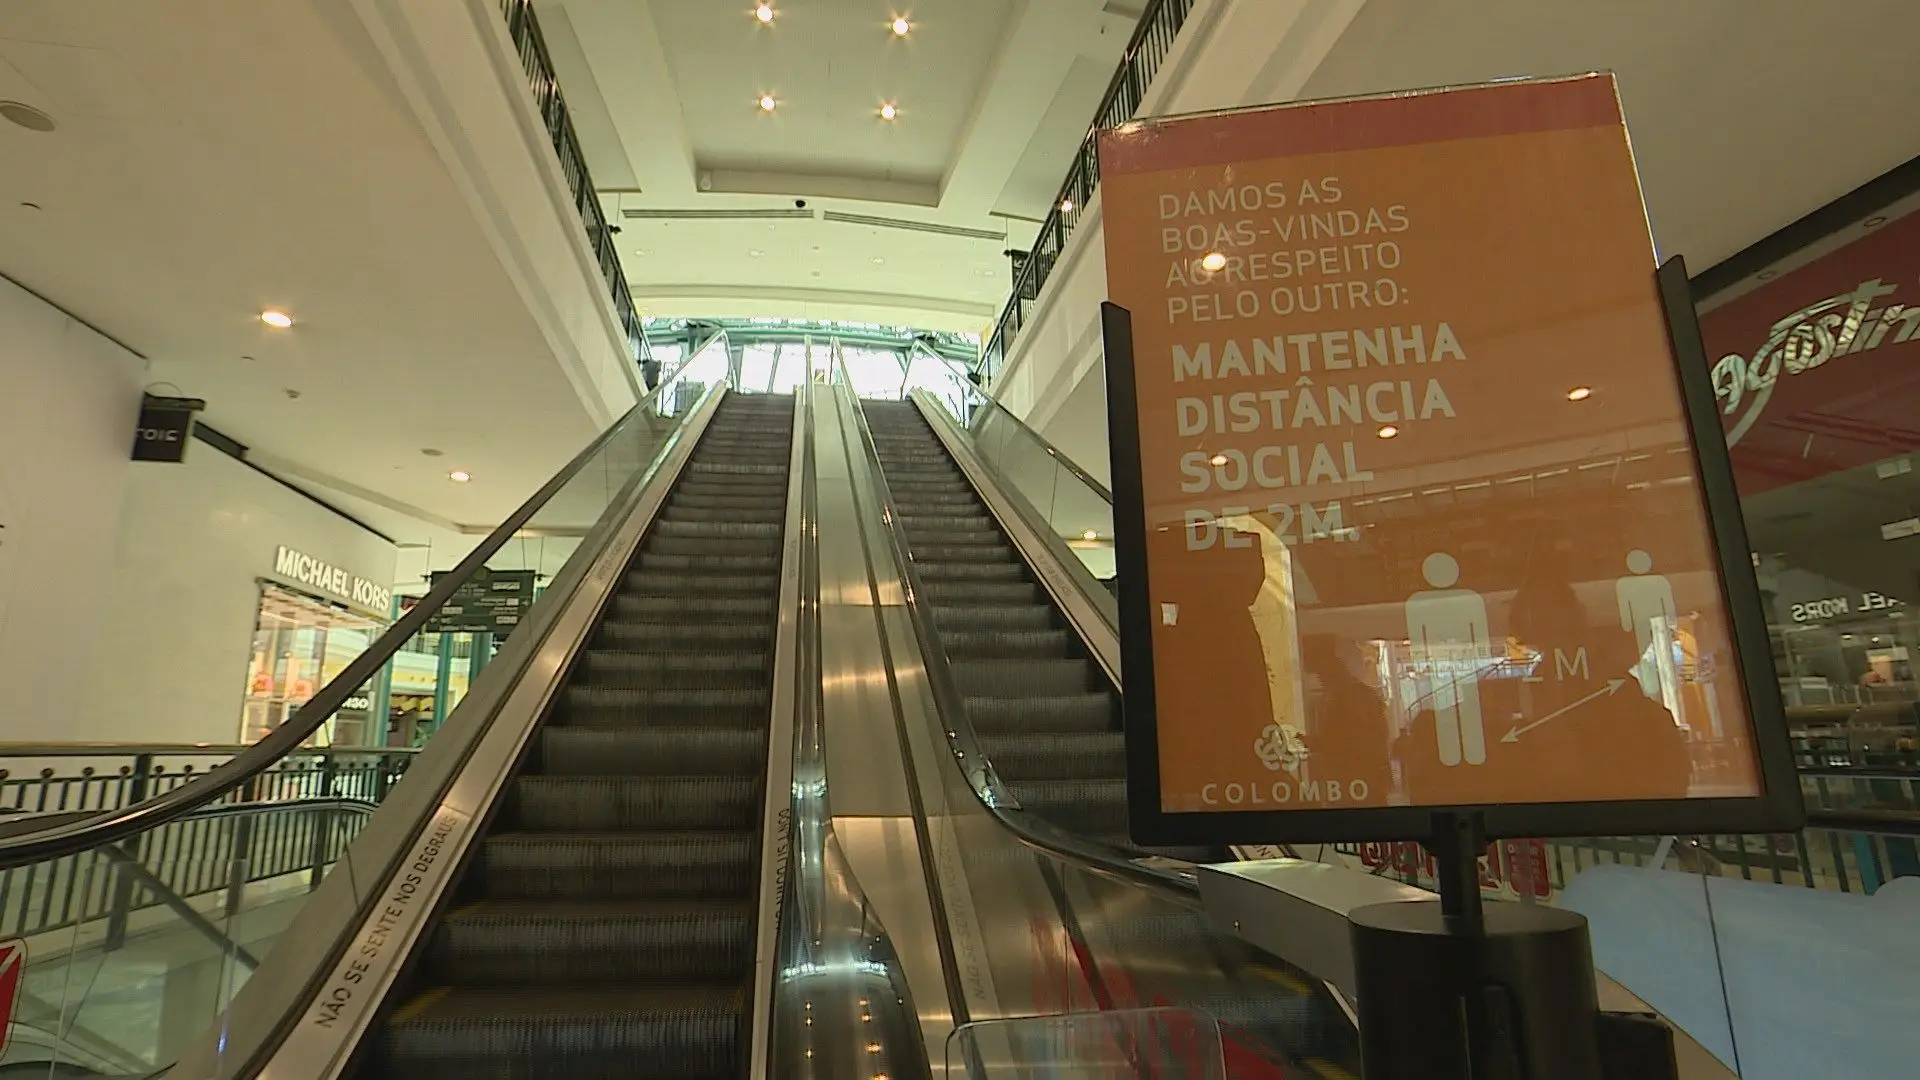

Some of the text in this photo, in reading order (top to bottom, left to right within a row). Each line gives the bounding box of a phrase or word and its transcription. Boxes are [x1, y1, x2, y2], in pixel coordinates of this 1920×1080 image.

[1158, 177, 1343, 219] DAMOS AS
[1161, 205, 1411, 254] BOAS-VINDAS
[1224, 241, 1401, 283] RESPEITO
[1167, 278, 1410, 324] PELO OUTRO:
[1171, 322, 1467, 382] MANTENHA
[1175, 376, 1456, 437] DISTÂNCIA
[1180, 441, 1374, 493] SOCIAL
[1184, 500, 1360, 551] DE 2M.
[276, 546, 390, 612] MICHAEL KORS
[1202, 779, 1369, 804] COLOMBO
[314, 816, 457, 1028] NÃO SE SENTE NOS DEGRAUS
